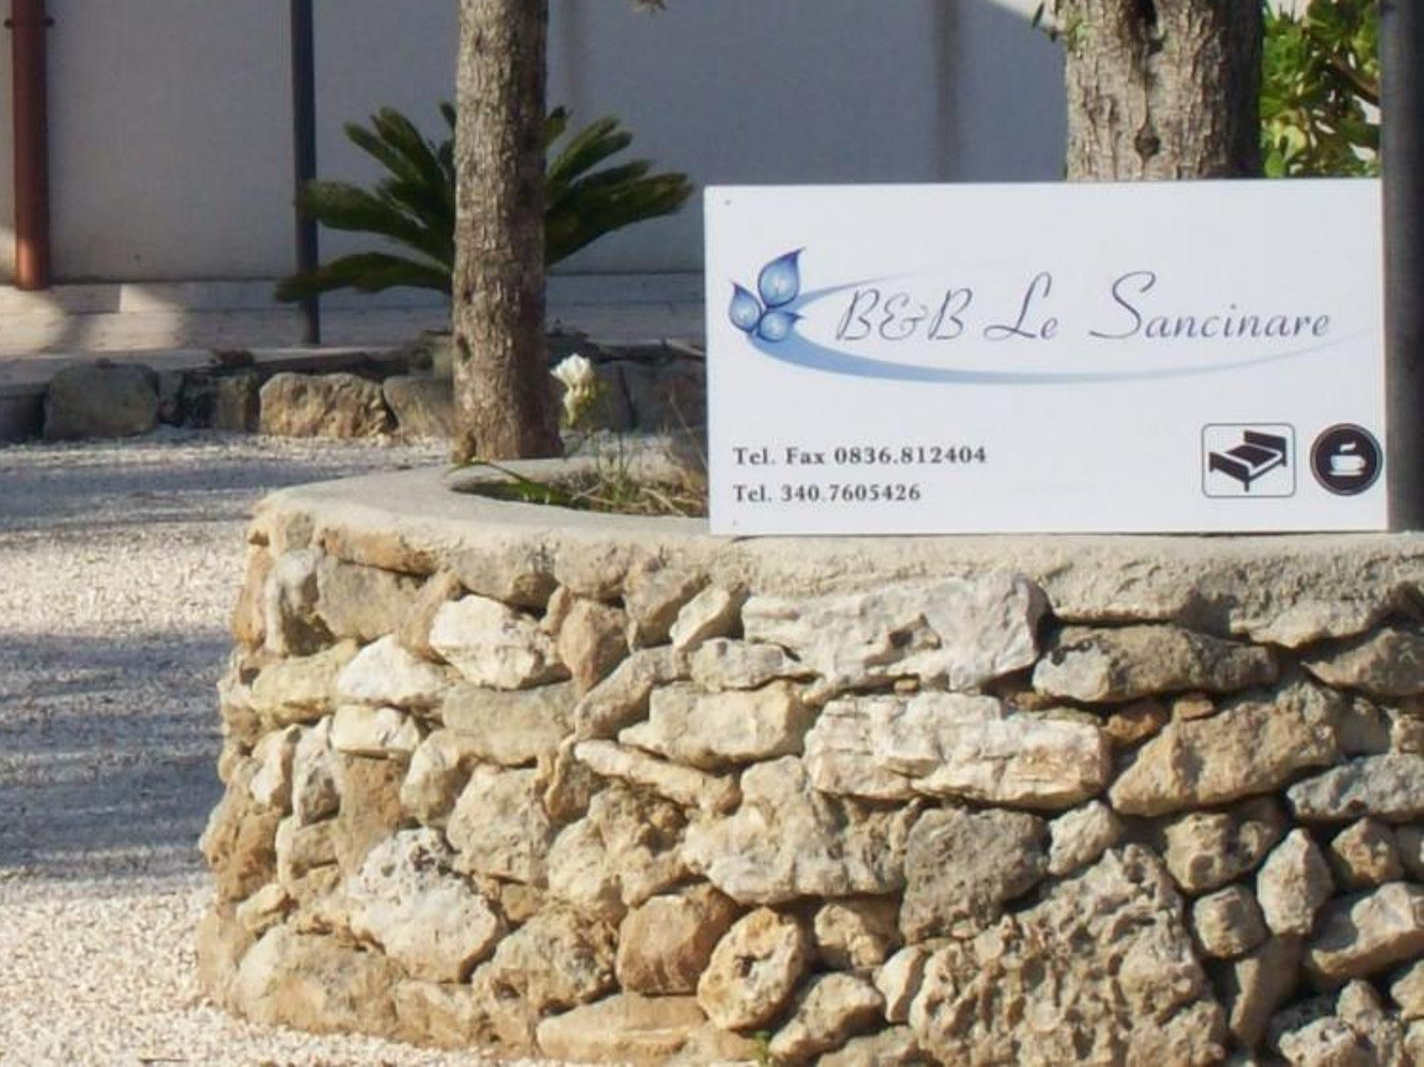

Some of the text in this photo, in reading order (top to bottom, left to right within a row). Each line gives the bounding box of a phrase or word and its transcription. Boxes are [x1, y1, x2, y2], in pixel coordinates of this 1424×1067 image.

[835, 270, 1331, 341] B&B Le Sancinare
[733, 445, 987, 466] Tel. Fax 0836.812404
[733, 483, 922, 503] Tel. 340.7605426
